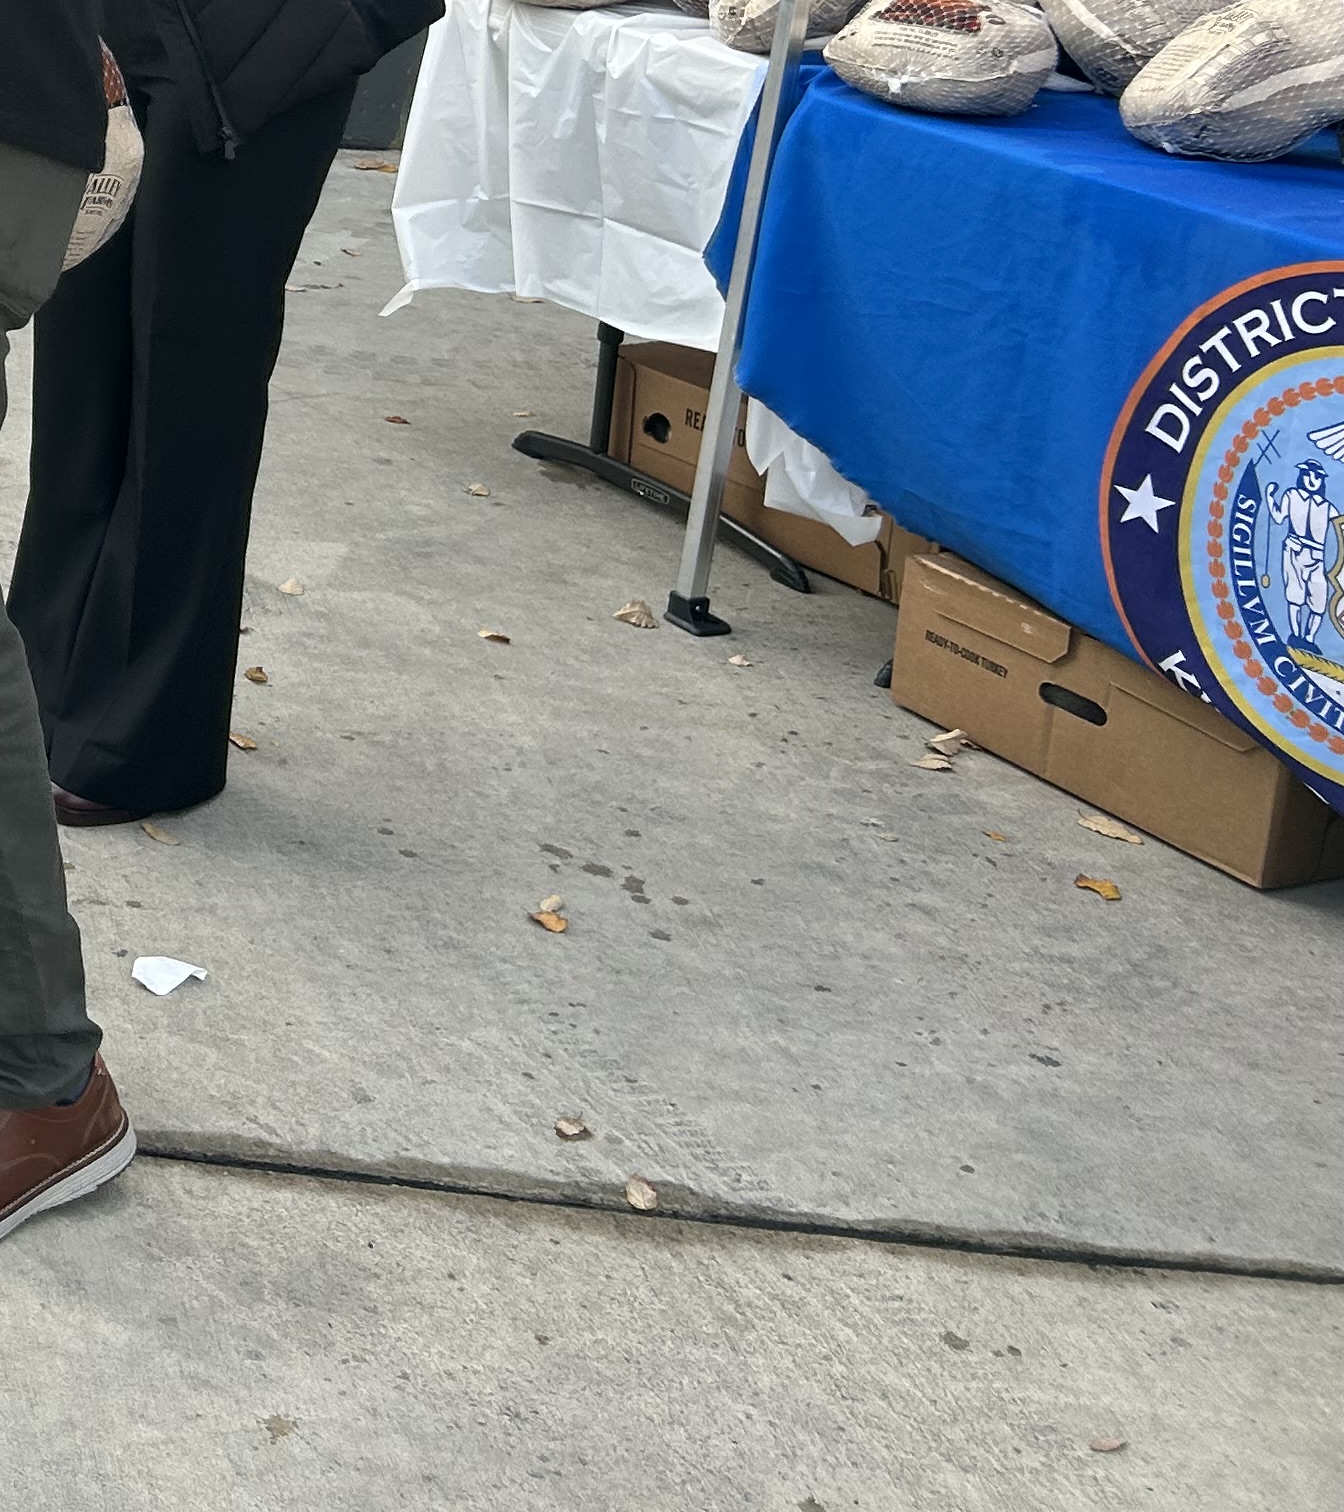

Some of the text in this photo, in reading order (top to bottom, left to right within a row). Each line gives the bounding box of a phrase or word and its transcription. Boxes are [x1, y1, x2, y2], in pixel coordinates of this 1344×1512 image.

[1145, 288, 1344, 453] DISTRIC
[1231, 491, 1278, 646] SIGILLVM
[981, 656, 1009, 678] TURKEY
